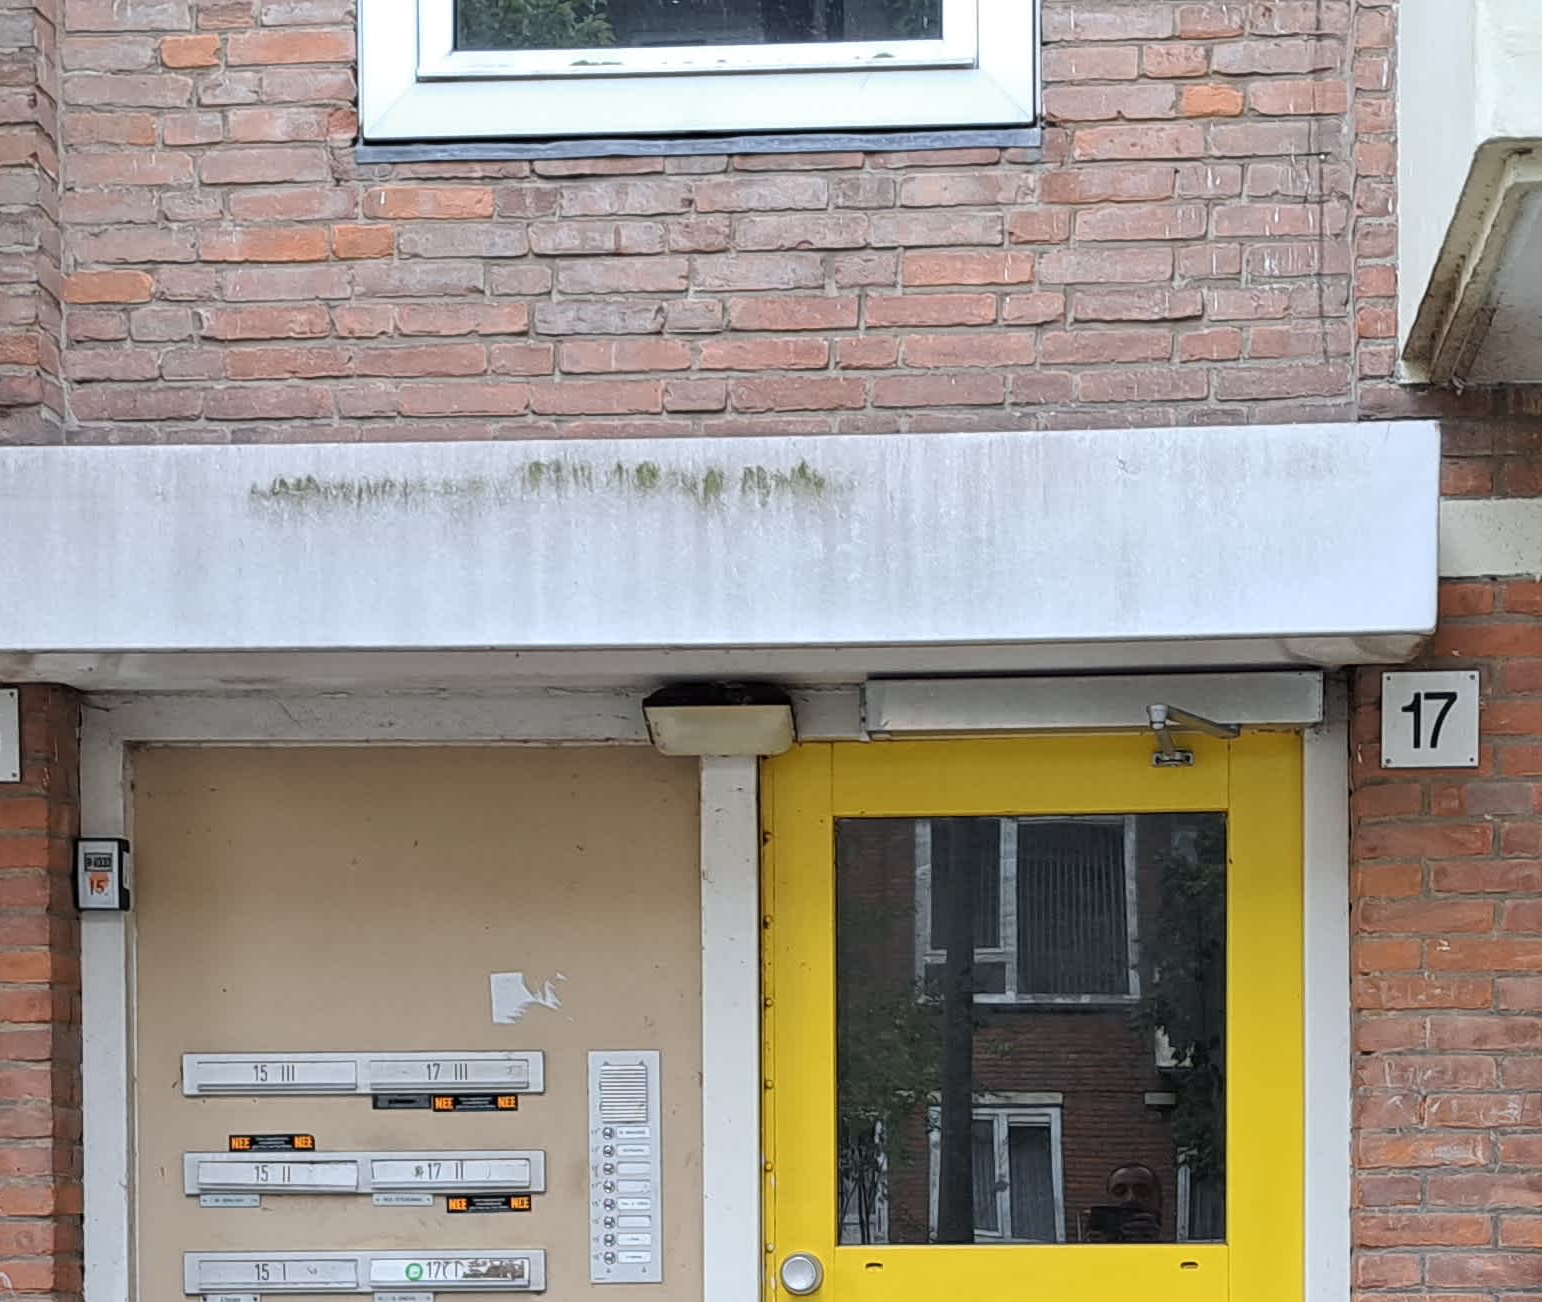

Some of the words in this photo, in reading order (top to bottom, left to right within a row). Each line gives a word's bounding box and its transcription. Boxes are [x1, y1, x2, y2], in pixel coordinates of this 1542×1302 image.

[1401, 691, 1458, 749] 17
[253, 1064, 268, 1082] 15
[281, 1064, 295, 1082] III
[426, 1063, 441, 1081] 17
[454, 1063, 468, 1081] III
[434, 1097, 454, 1110] NEE
[497, 1095, 516, 1108] NEE
[231, 1137, 252, 1150] NEE
[294, 1135, 313, 1149] NEE
[254, 1165, 269, 1182] 15
[282, 1165, 291, 1182] II
[427, 1162, 442, 1180] 17
[455, 1162, 464, 1180] II
[448, 1198, 468, 1211] NEE
[511, 1196, 529, 1209] NEE
[254, 1263, 270, 1281] 15
[426, 1261, 441, 1278] 17
